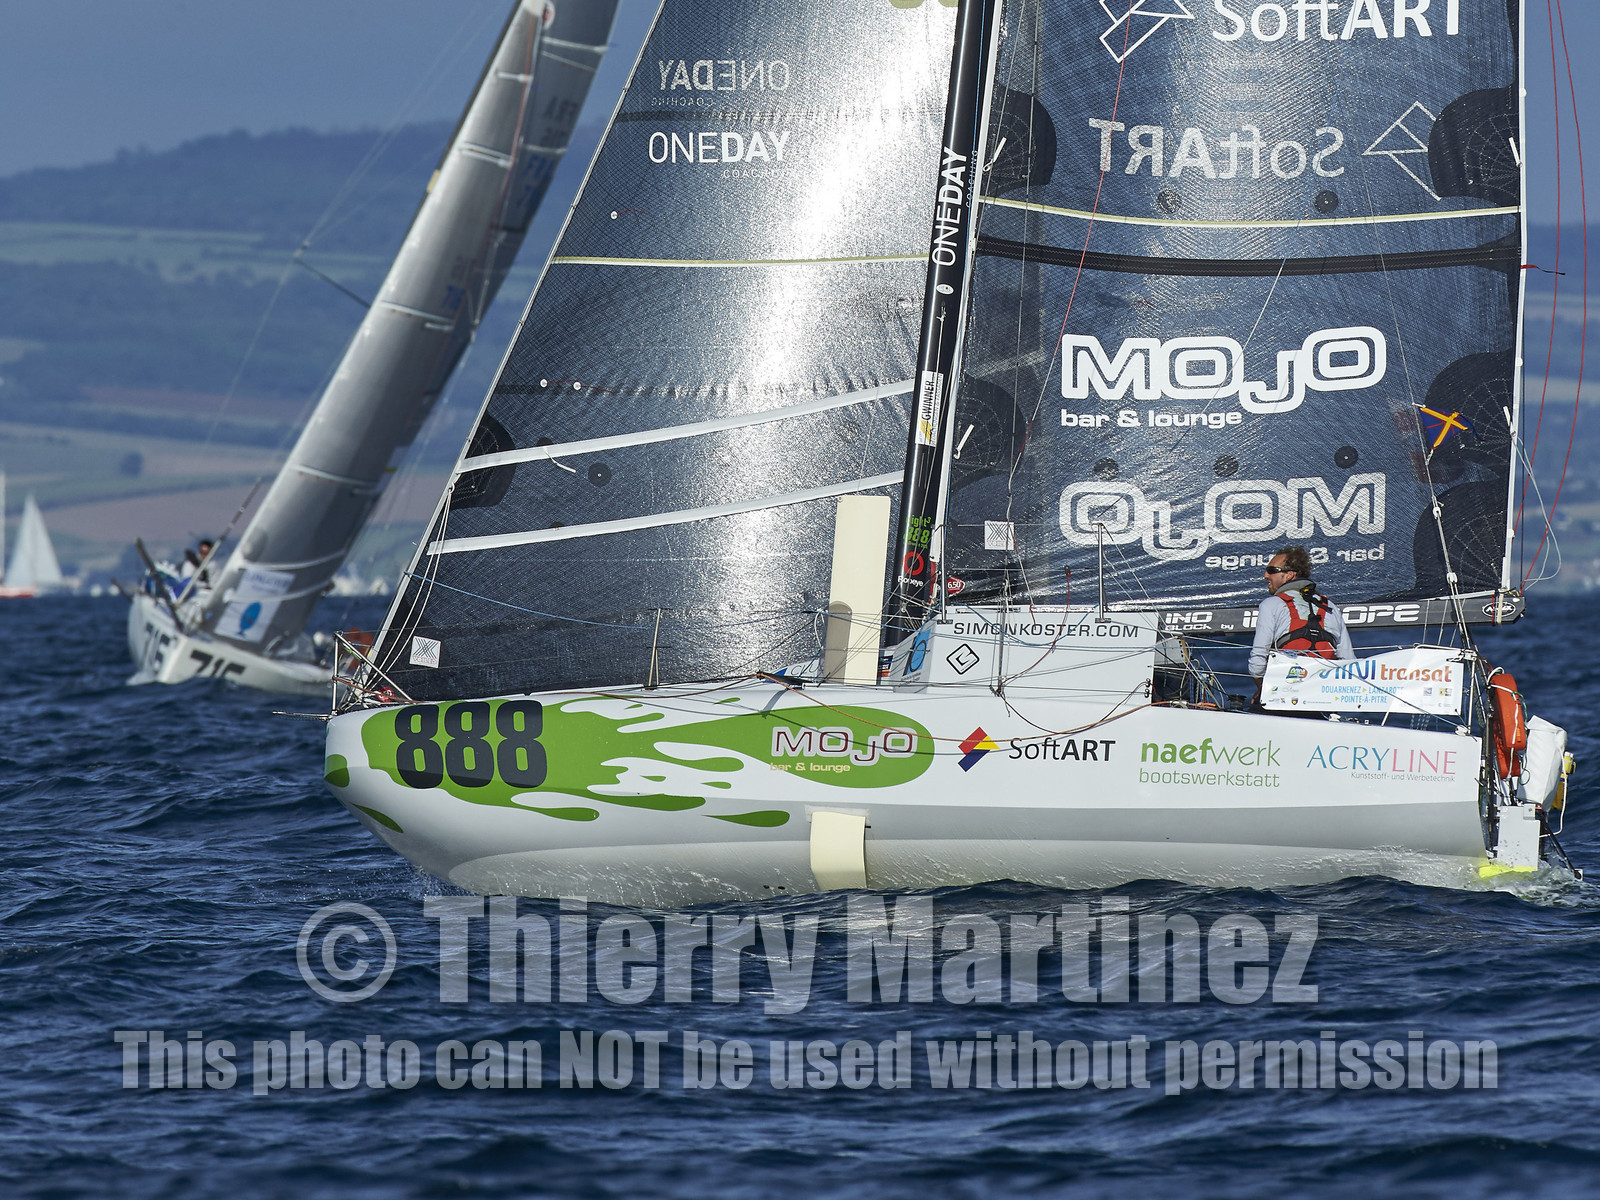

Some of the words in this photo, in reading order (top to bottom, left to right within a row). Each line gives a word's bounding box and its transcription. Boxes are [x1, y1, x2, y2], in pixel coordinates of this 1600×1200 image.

[649, 132, 791, 164] ONEDAY
[932, 146, 967, 267] ONEDAY
[1061, 410, 1107, 427] bar
[1116, 410, 1141, 427] &
[1149, 410, 1243, 429] lounge
[953, 622, 1139, 638] SIMONKOSTER.COM
[1381, 664, 1452, 682] transat
[1321, 685, 1361, 694] DOUARNENEZ
[394, 700, 548, 789] 888
[1008, 737, 1116, 761] SoftART
[1141, 738, 1280, 766] naefwerk
[770, 763, 792, 771] bar
[795, 763, 806, 771] &
[810, 763, 851, 773] lounge
[1306, 745, 1457, 774] ACRYLINE
[1139, 768, 1280, 787] bootswerkstatt
[1391, 773, 1405, 781] und
[1407, 774, 1456, 783] Werbetechnik
